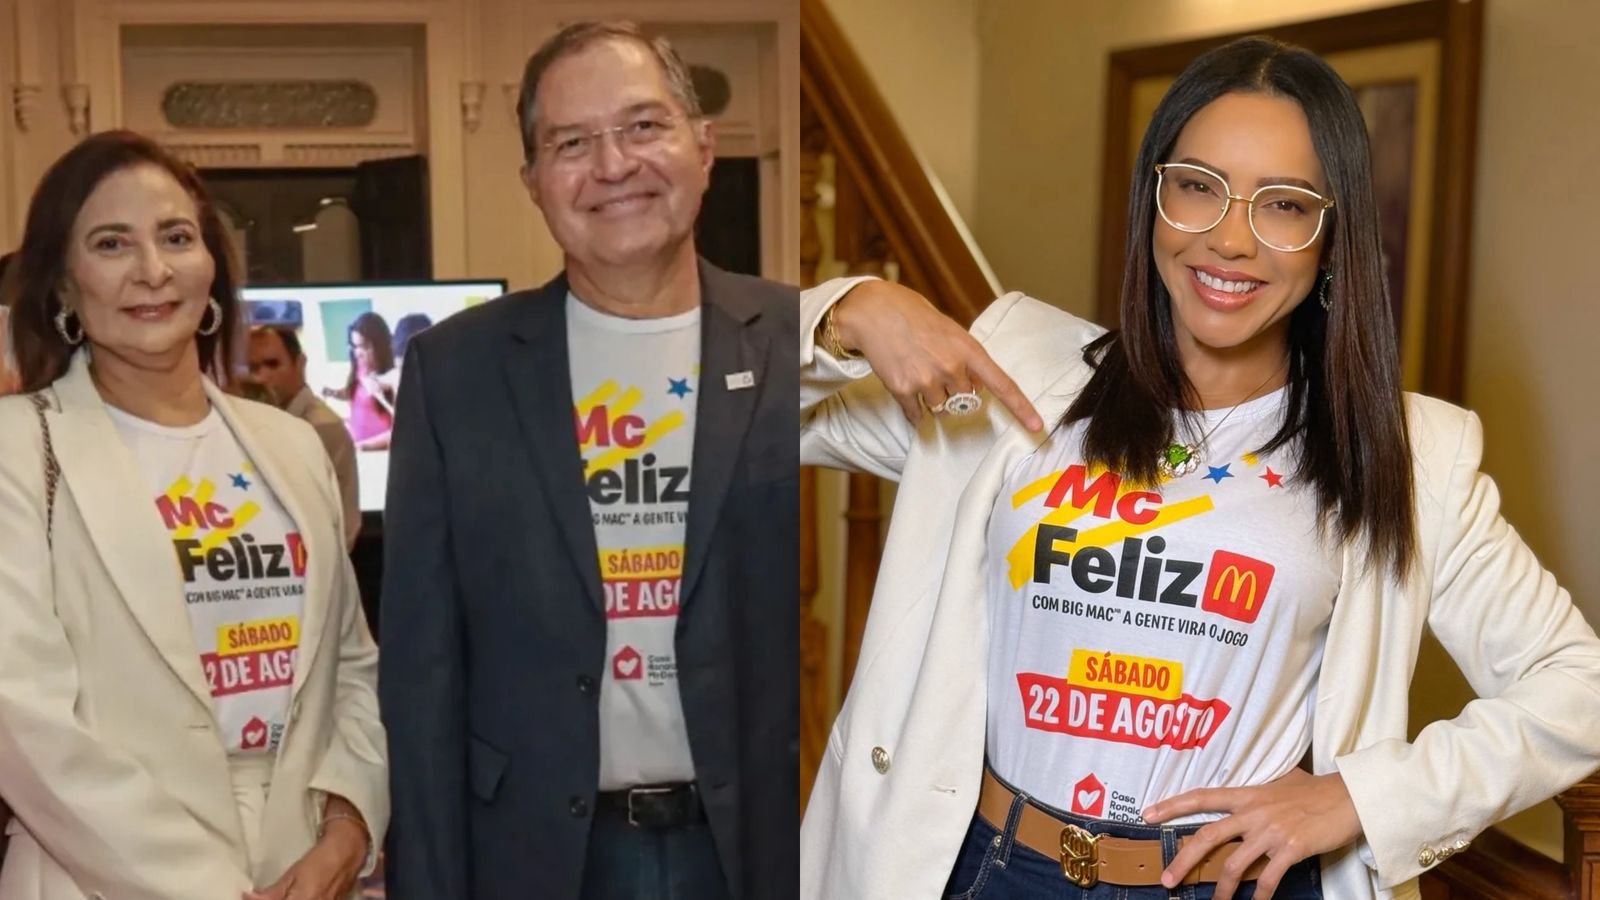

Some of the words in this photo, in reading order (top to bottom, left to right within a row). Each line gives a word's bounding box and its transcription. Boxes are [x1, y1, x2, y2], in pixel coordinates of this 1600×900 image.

[572, 405, 646, 449] Mc
[583, 453, 690, 505] eliz
[1044, 464, 1163, 525] Mc
[154, 494, 235, 530] Mc
[633, 513, 640, 525] A
[643, 511, 675, 525] GENTE
[172, 533, 290, 582] Feliz
[608, 549, 680, 574] SÁBADO
[1033, 523, 1204, 608] Feliz
[246, 588, 253, 599] A
[228, 622, 292, 649] SÁBADO
[1032, 595, 1059, 612] COM
[1062, 599, 1083, 617] BIG
[1122, 611, 1132, 625] A
[1135, 612, 1175, 631] GENTE
[1178, 619, 1206, 636] VIRA
[1209, 624, 1218, 638] O
[1217, 628, 1249, 647] JOGO
[220, 656, 253, 688] DE
[1085, 651, 1170, 691] SÁBADO
[1029, 684, 1060, 724] 22
[1068, 689, 1107, 731] DE
[1111, 697, 1215, 744] AGOSTO
[1111, 790, 1136, 804] Casa
